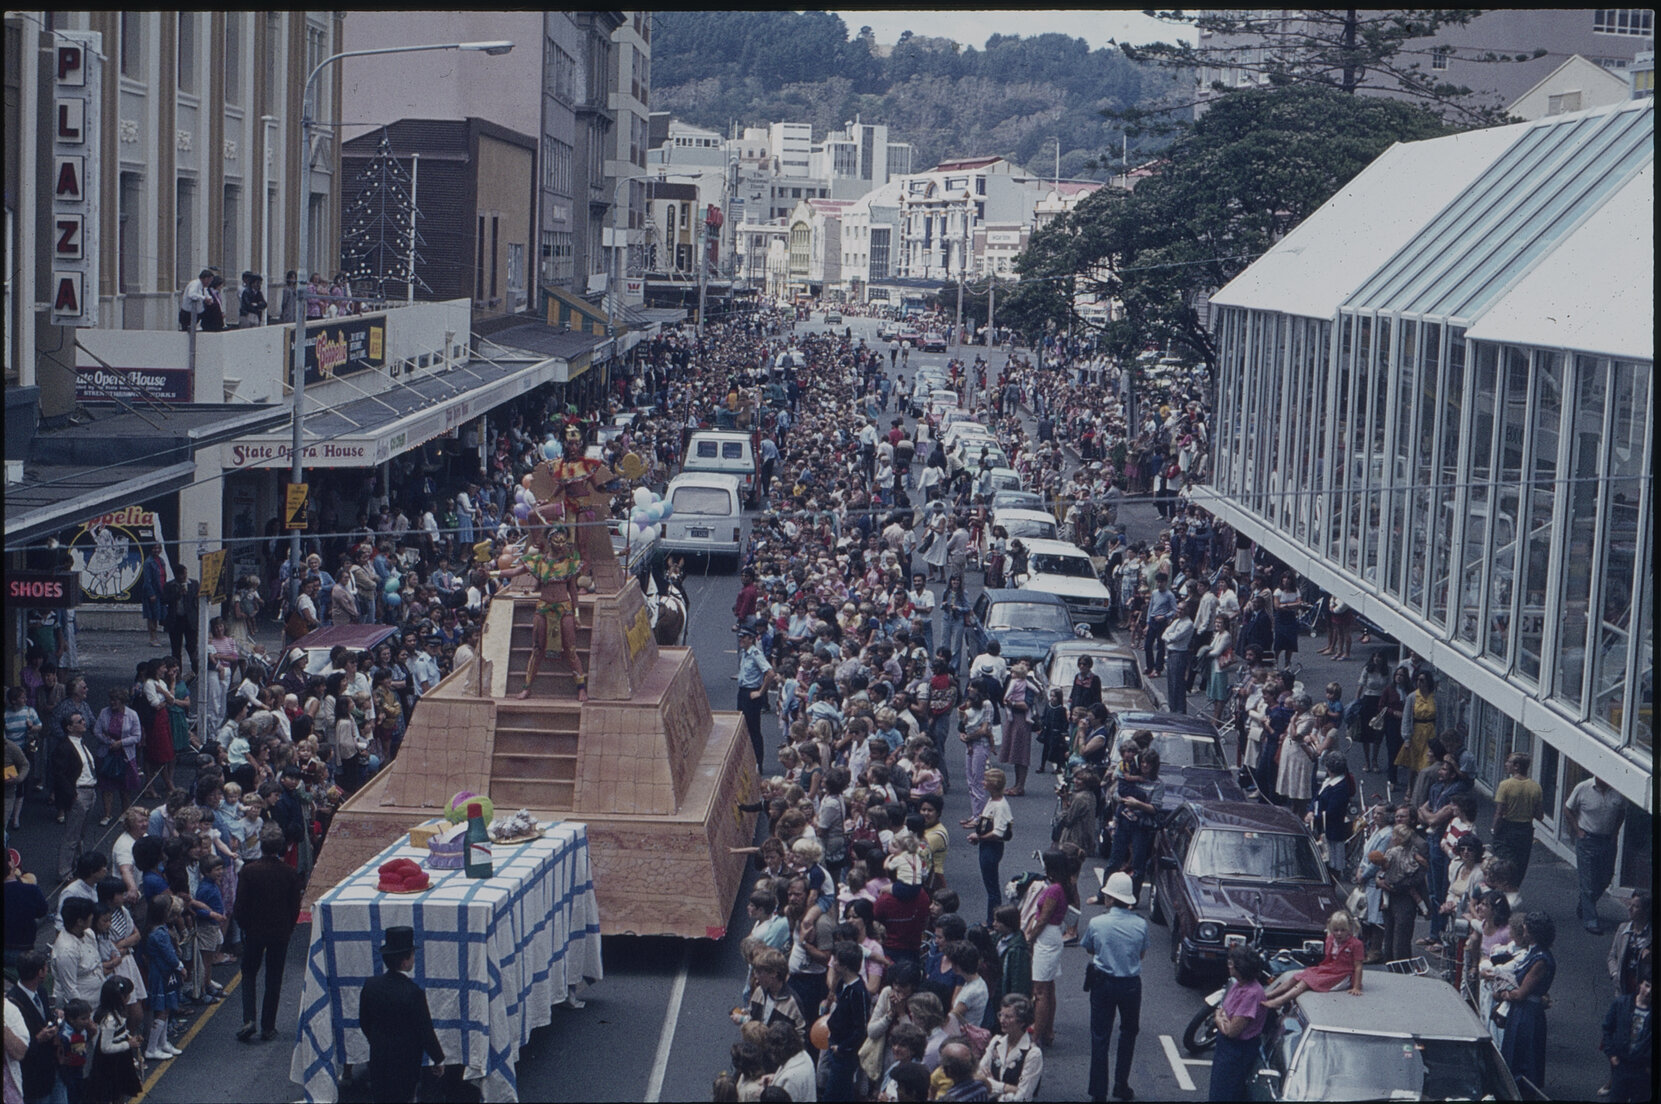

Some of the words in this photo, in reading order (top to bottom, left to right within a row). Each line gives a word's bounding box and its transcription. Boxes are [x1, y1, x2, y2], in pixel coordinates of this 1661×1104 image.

[54, 46, 80, 311] PLAZA
[76, 374, 93, 384] ate
[128, 371, 167, 386] House
[233, 444, 272, 466] State
[278, 444, 317, 461] Opra
[323, 444, 364, 458] House
[86, 506, 154, 530] ppelia
[10, 580, 64, 598] SHOES
